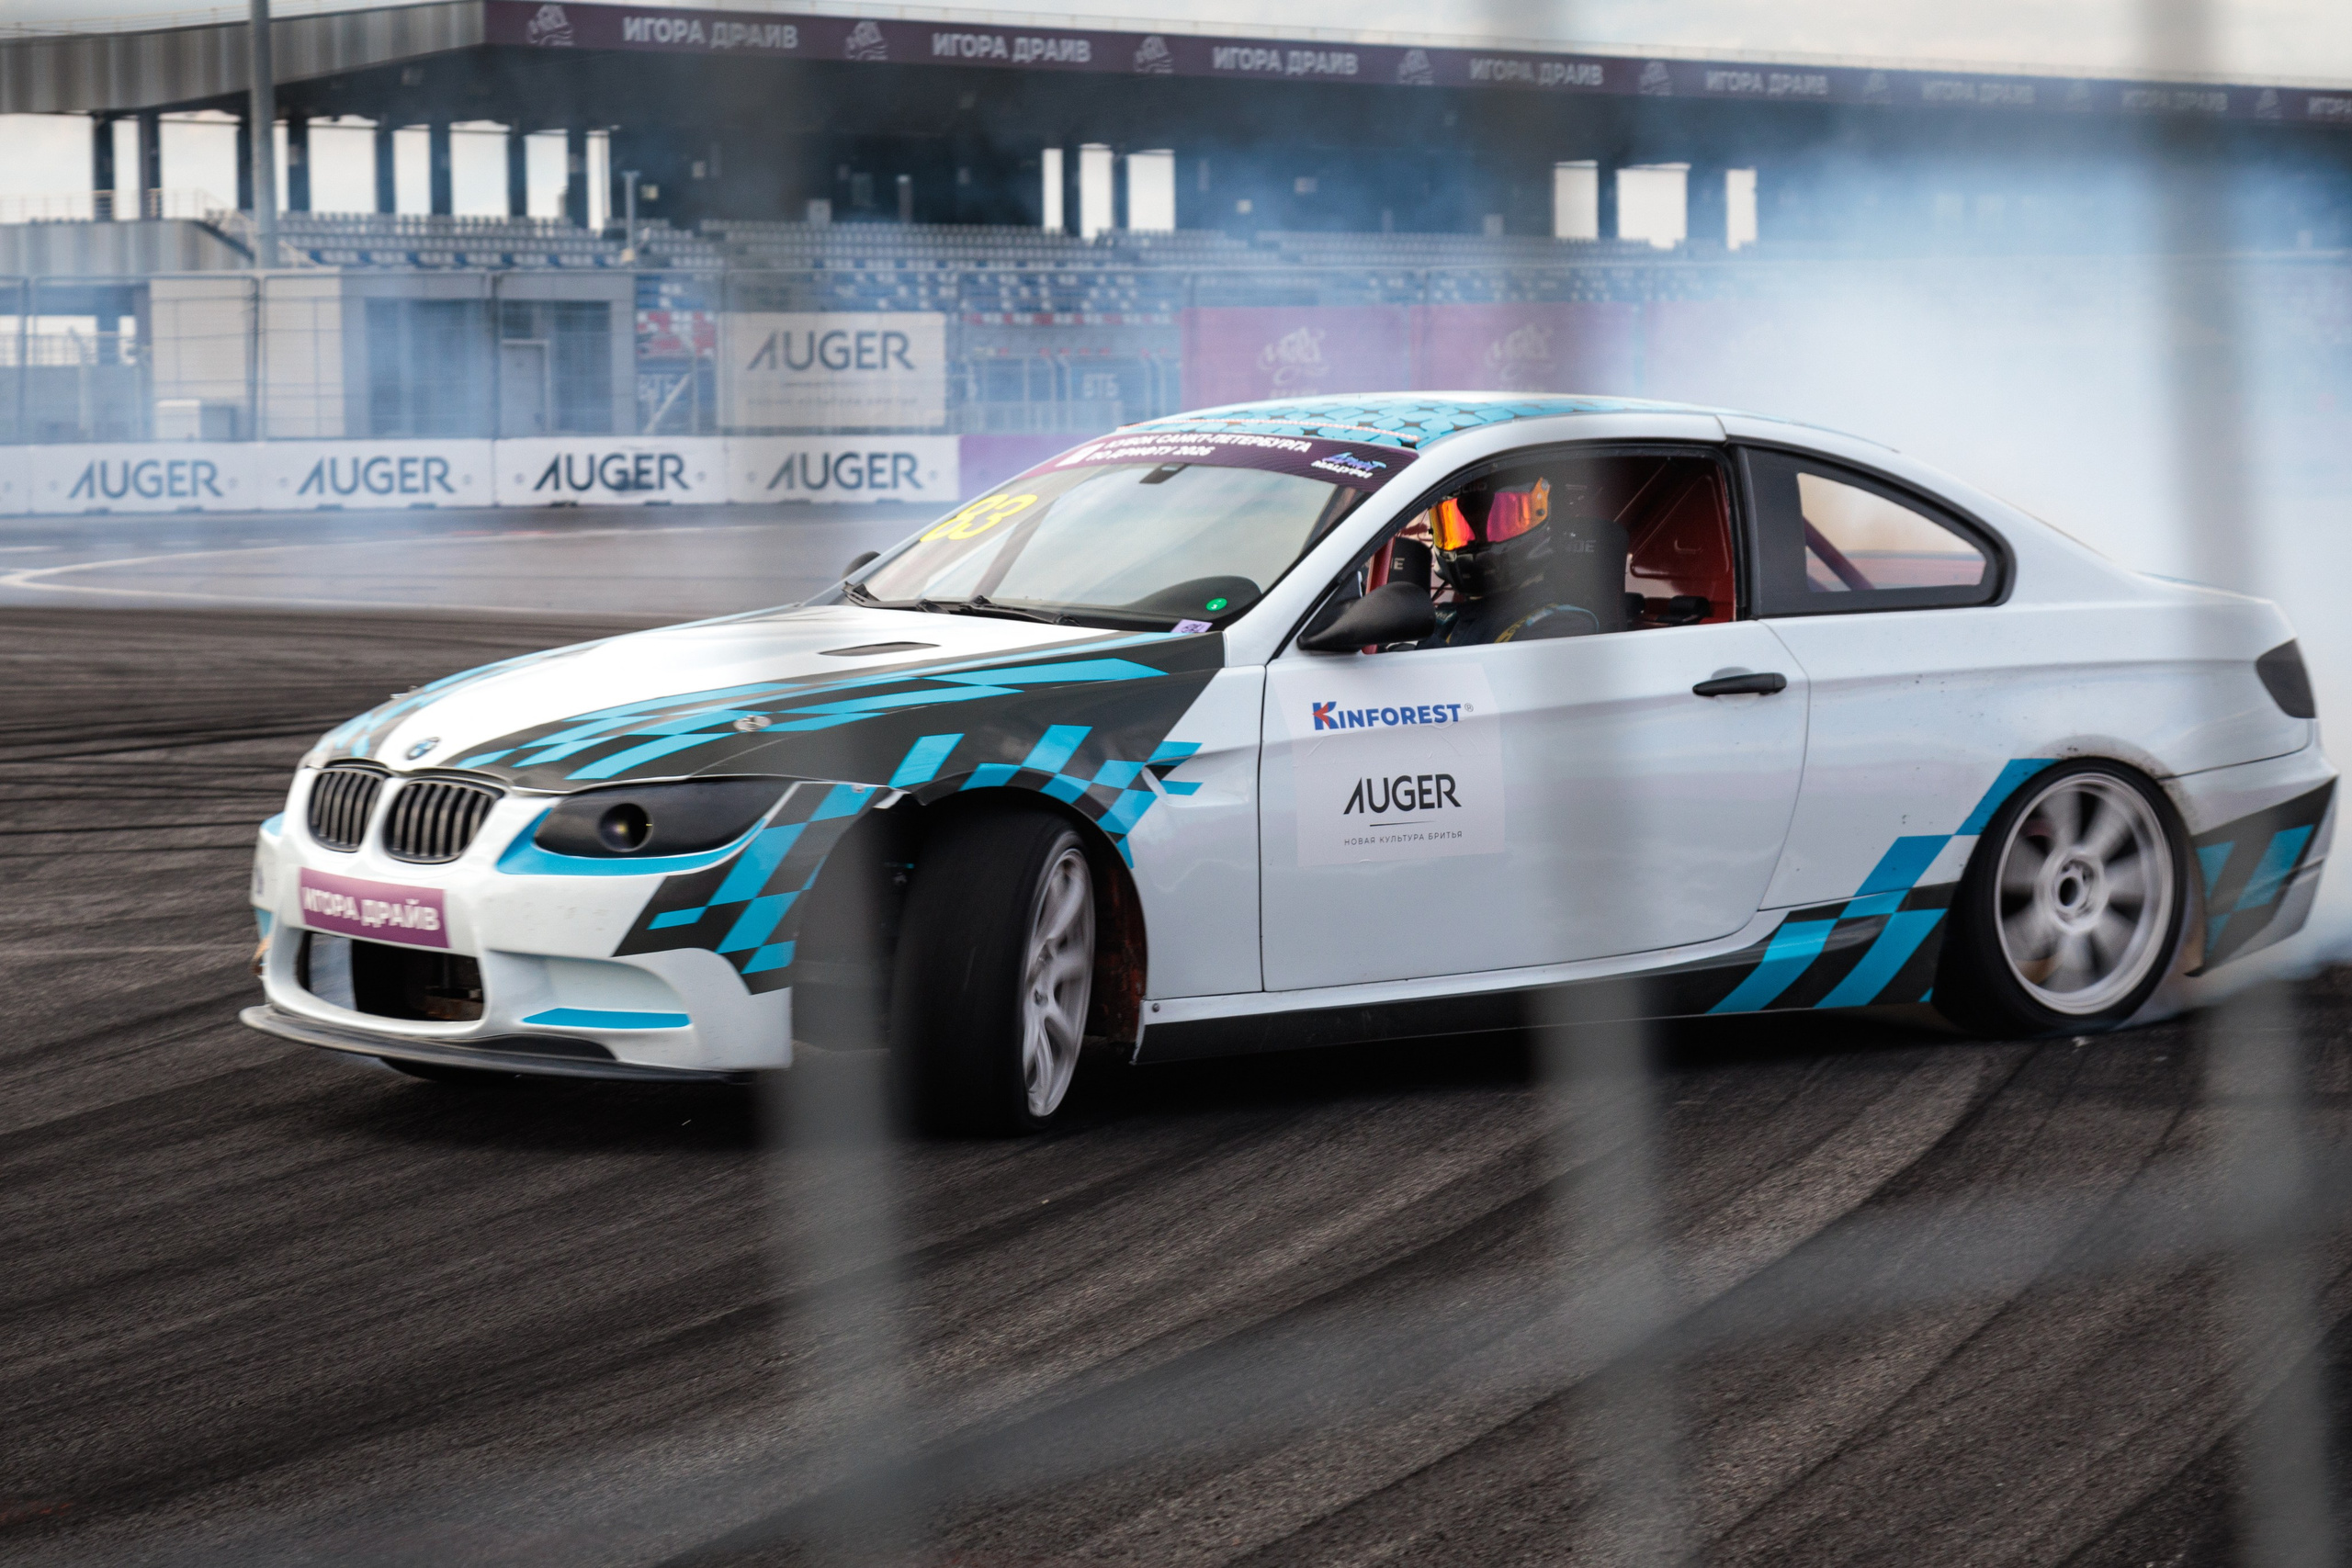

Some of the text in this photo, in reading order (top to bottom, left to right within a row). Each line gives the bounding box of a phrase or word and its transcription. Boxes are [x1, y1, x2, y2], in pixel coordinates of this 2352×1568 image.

[623, 16, 706, 44] ИГОРА
[932, 32, 1009, 60] ИГОРА
[1213, 46, 1283, 73] ИГОРА
[746, 329, 917, 370] AUGER
[1156, 434, 1313, 453] САНКТ-ПЕТЕРБУРГА
[69, 459, 223, 499] AUGER
[297, 456, 456, 496] AUGER
[533, 453, 691, 491] AUGER
[766, 451, 923, 491] AUGER
[920, 493, 1038, 543] 83
[1312, 701, 1462, 730] KINFOREST
[1343, 773, 1463, 815] AUGER
[1344, 830, 1463, 846] НОВАЯ КУЛЬТУРА БРИТЬЯ
[302, 886, 441, 931] ИГОРА ДРАЙВ
